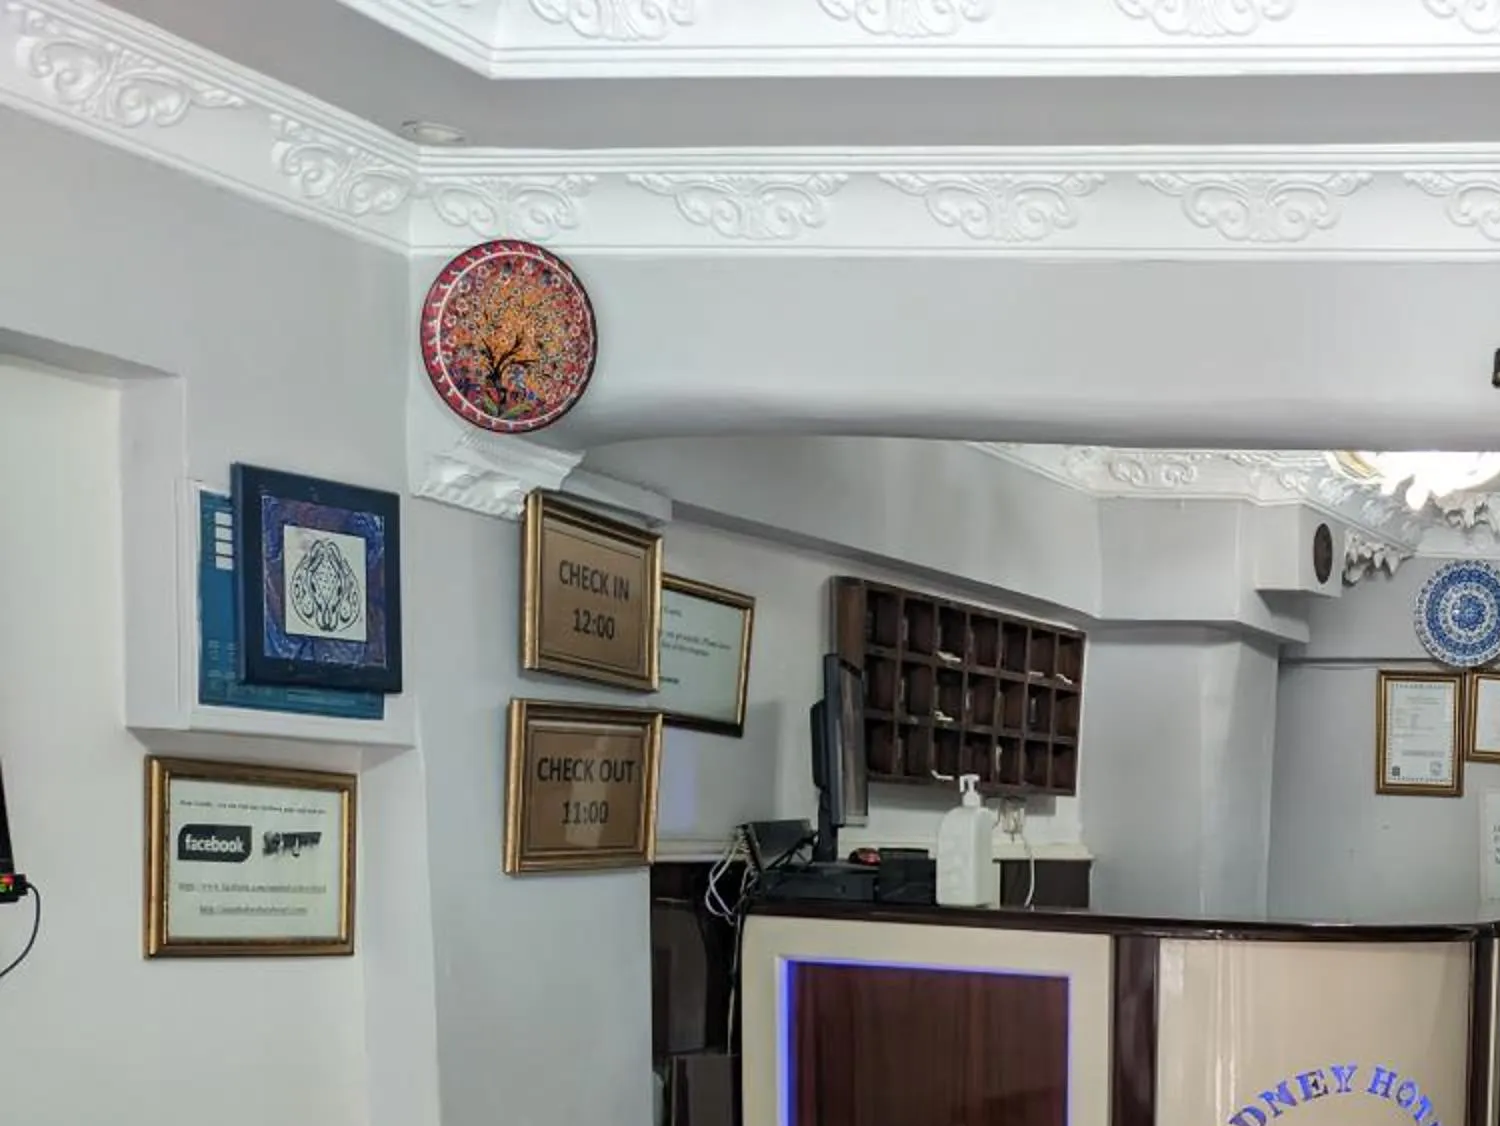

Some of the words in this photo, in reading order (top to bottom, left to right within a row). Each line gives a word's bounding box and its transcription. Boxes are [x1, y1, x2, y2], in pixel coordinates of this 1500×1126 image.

[559, 559, 609, 597] CHECK
[613, 575, 630, 602] IN
[573, 608, 615, 640] 12:00
[537, 756, 596, 784] CHECK
[599, 758, 636, 784] OUT
[561, 800, 609, 825] 11:00
[184, 833, 245, 853] facebook
